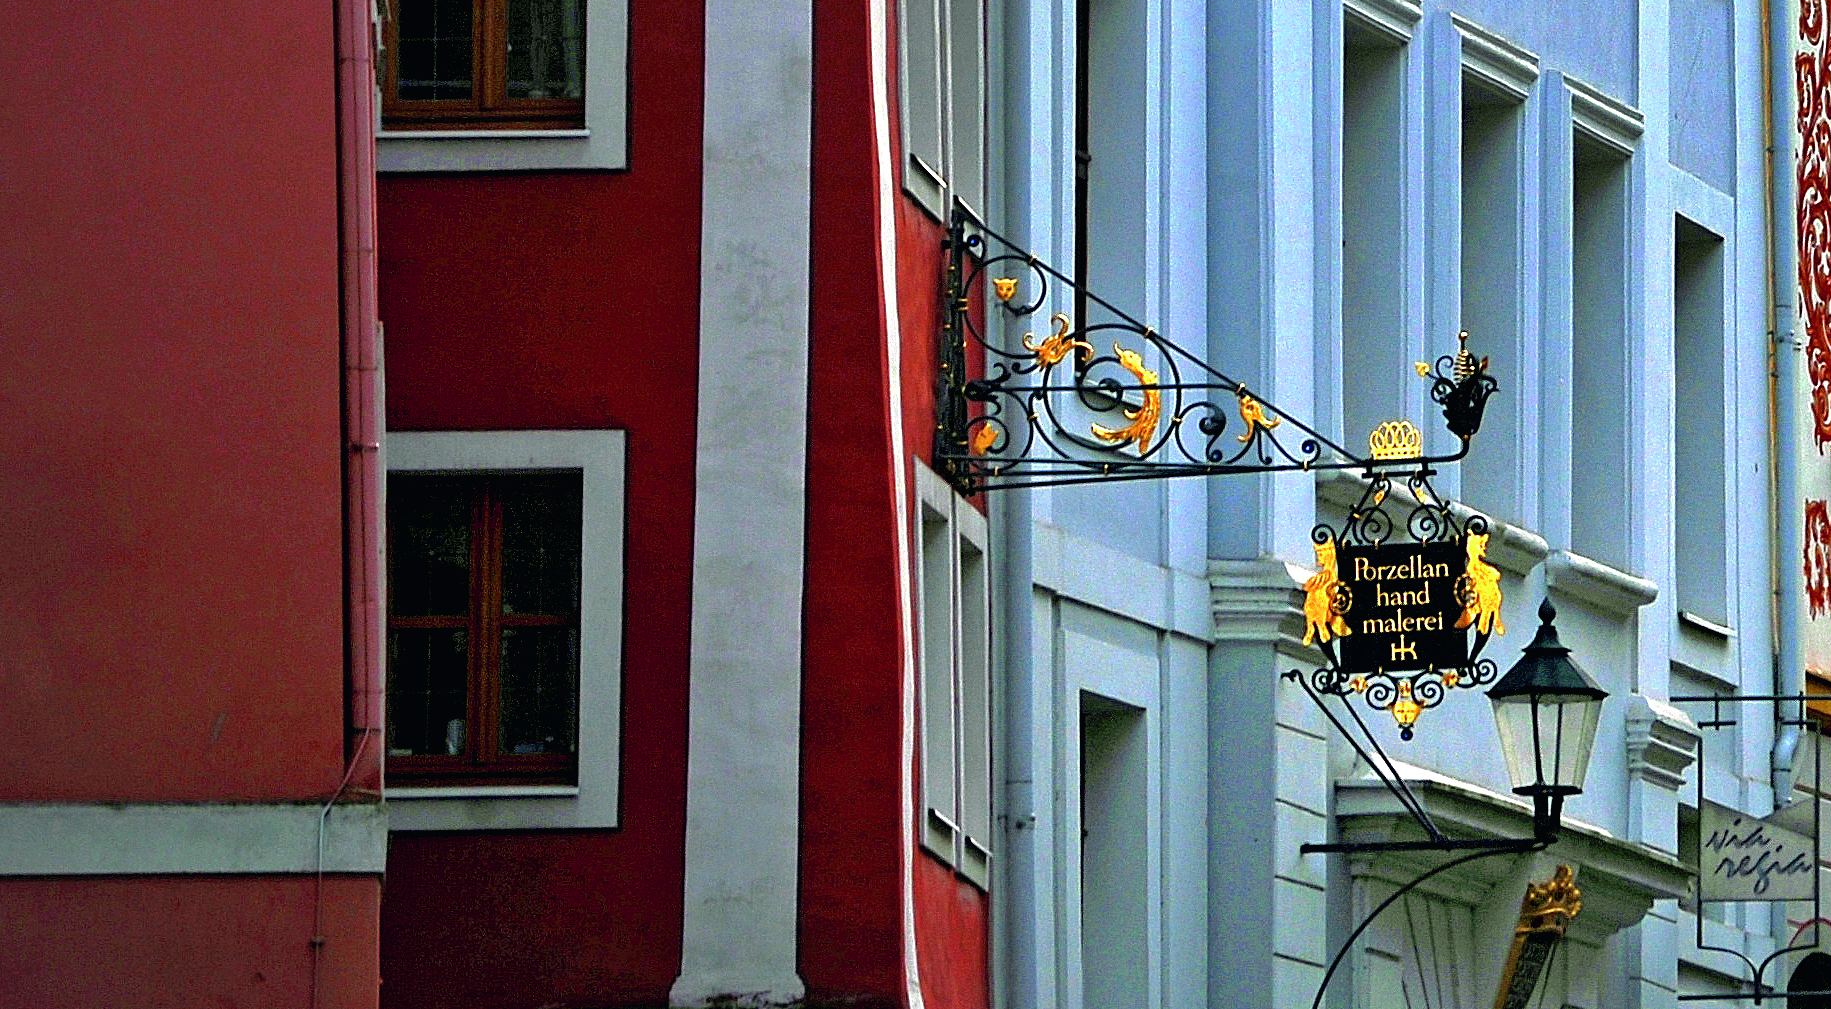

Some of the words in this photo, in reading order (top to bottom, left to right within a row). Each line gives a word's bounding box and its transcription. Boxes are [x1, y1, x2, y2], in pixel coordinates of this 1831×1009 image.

[1354, 554, 1450, 581] Porzellan
[1376, 580, 1431, 606] hand
[1363, 608, 1444, 634] malerei
[1705, 818, 1771, 853] via
[1714, 845, 1813, 894] regia
